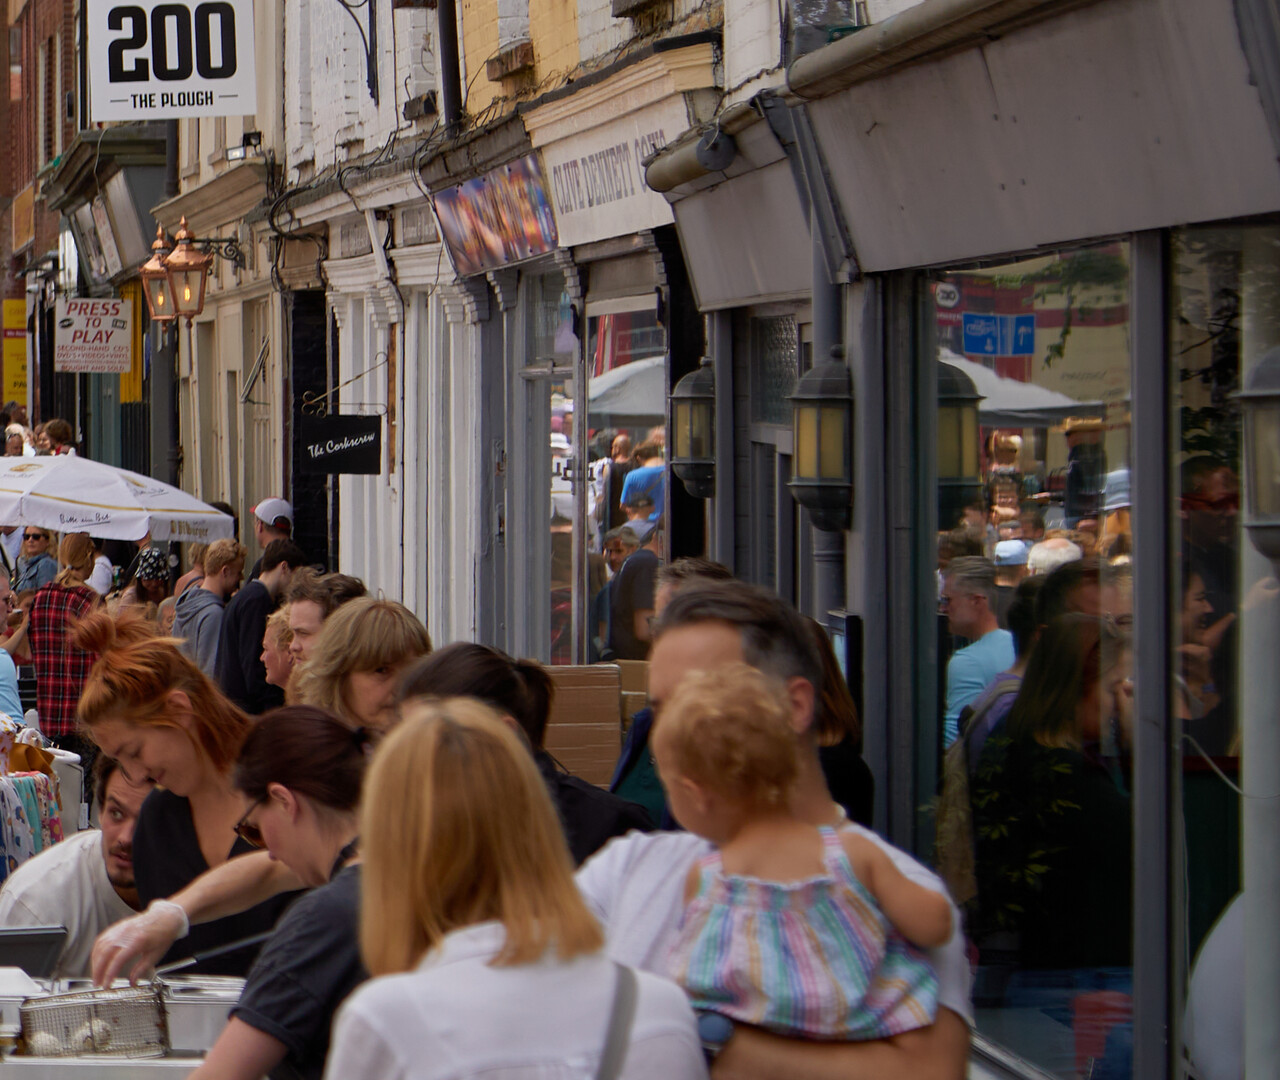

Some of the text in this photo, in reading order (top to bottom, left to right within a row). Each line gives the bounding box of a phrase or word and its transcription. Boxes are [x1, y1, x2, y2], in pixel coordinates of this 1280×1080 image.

[107, 1, 238, 84] 200
[130, 90, 214, 109] THE PLOUGH
[552, 157, 585, 216] CLIVE
[580, 139, 637, 208] DENNETT
[66, 301, 121, 317] PRESS
[85, 317, 102, 329] TO
[71, 329, 115, 344] PLAY
[307, 432, 376, 458] The Corkscrew
